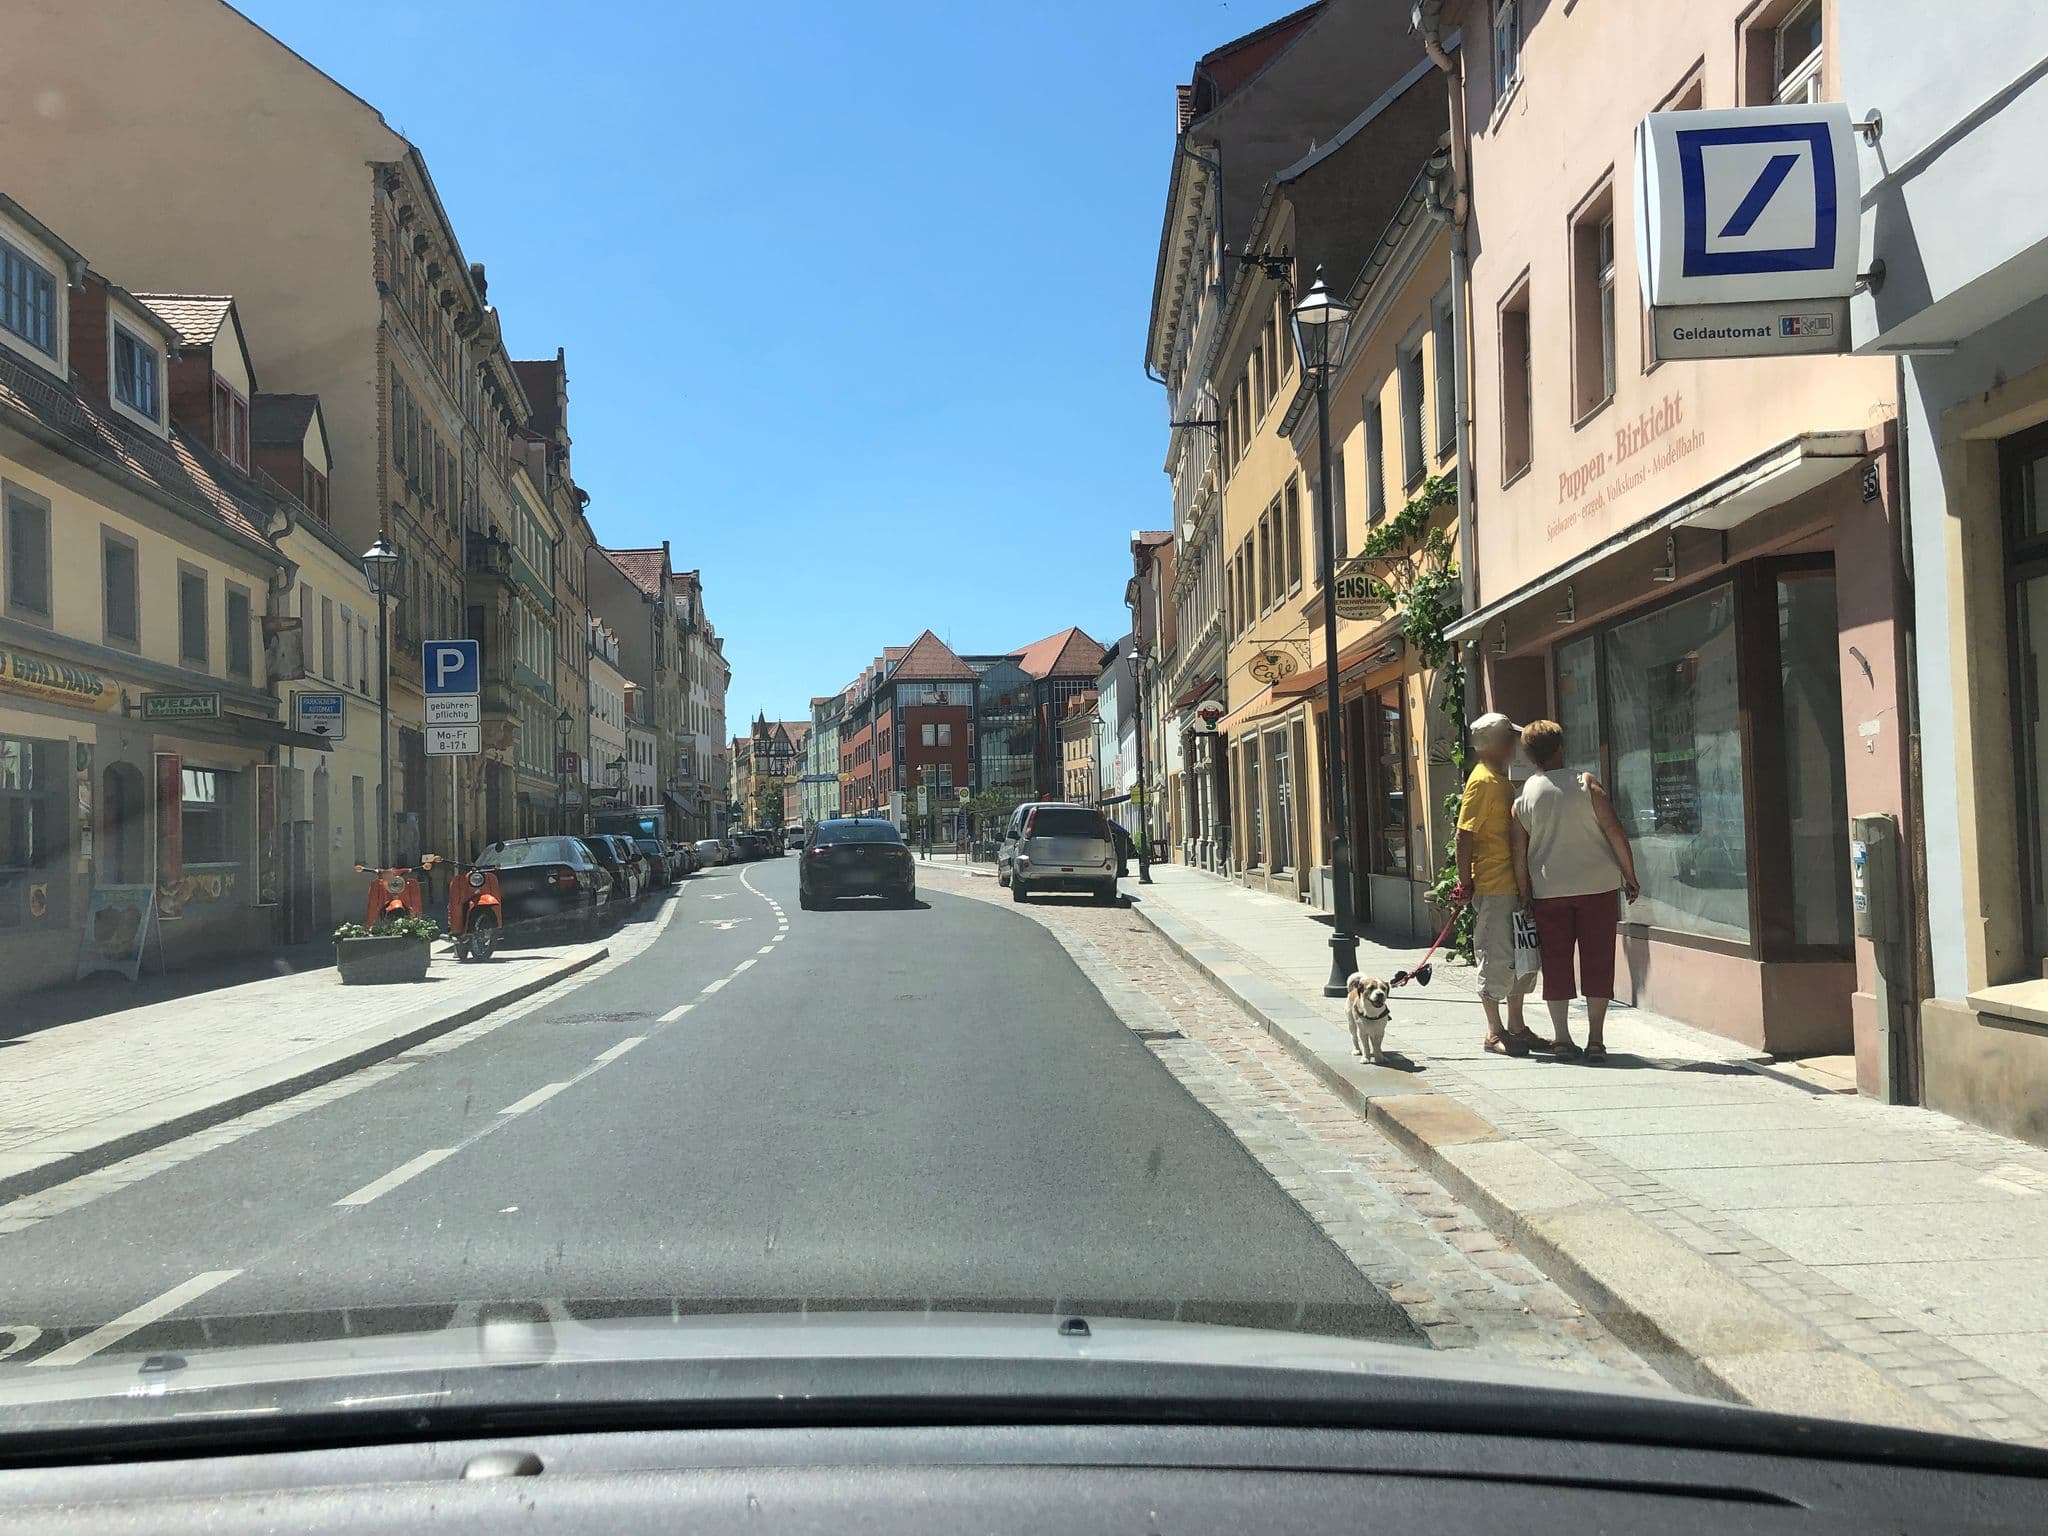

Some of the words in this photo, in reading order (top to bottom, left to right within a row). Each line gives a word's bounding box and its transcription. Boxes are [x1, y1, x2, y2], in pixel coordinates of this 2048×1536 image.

[1673, 326, 1772, 340] Geldautomat
[1559, 451, 1606, 505] Puppen
[1616, 391, 1683, 465] Birkicht
[1547, 513, 1577, 543] Spielwaren
[1606, 465, 1646, 503] Volkskunst
[1652, 429, 1705, 475] Modellbahn
[1338, 604, 1381, 612] Doppelzimmer
[436, 648, 465, 688] P
[1253, 660, 1295, 679] Café
[12, 654, 104, 697] GRILLHAUS
[150, 697, 211, 708] WELAT
[430, 701, 473, 711] gebühren-
[435, 710, 469, 720] pflichtig
[437, 730, 468, 740] Mo-Fr
